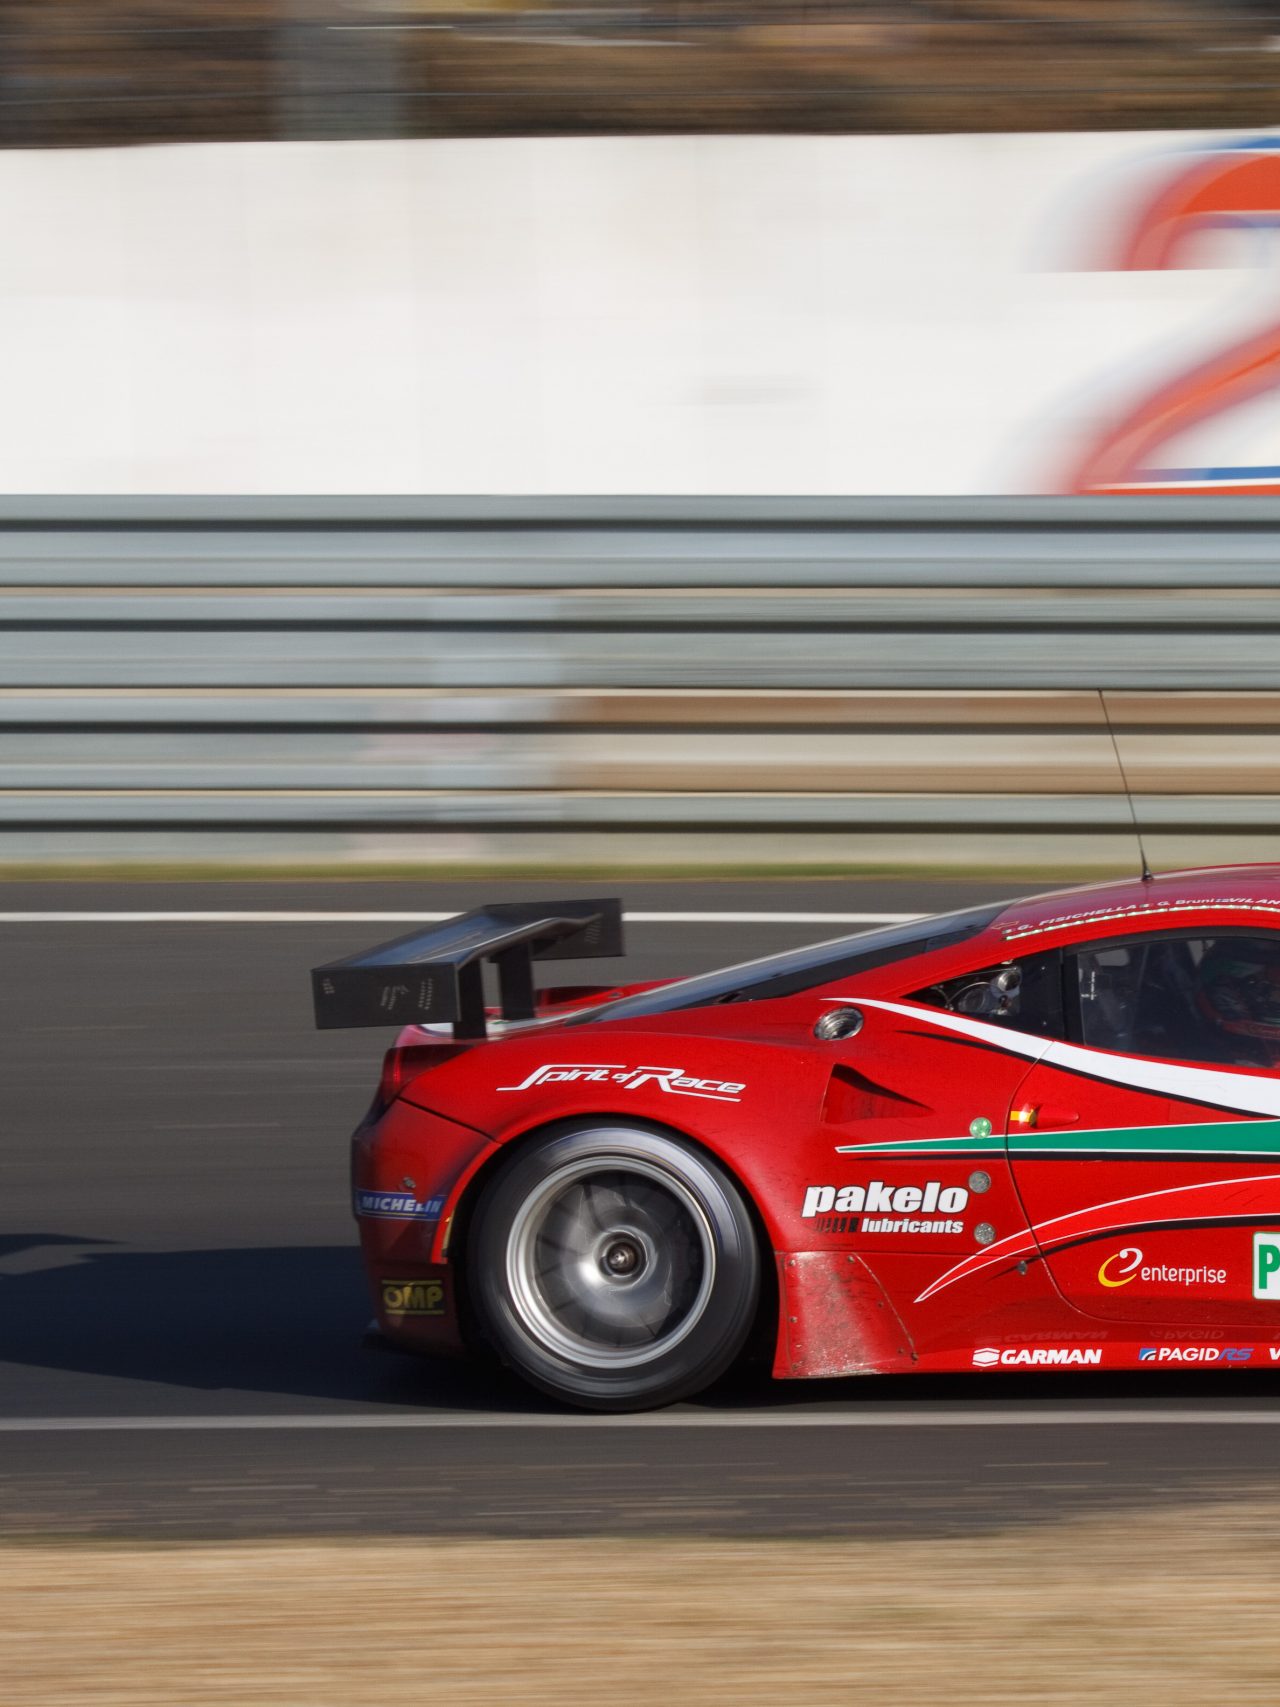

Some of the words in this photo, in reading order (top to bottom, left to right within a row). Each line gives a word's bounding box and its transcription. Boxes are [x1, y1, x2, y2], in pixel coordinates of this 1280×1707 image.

[1038, 903, 1137, 926] FISICHELLA
[496, 1064, 627, 1092] Spirit
[623, 1065, 746, 1103] Race
[361, 1196, 442, 1213] MICHELIN
[801, 1181, 969, 1217] pakelo
[861, 1218, 964, 1233] lubricants
[1140, 1264, 1227, 1287] enterprise
[382, 1286, 443, 1309] OMP
[1000, 1348, 1103, 1365] GARMAN
